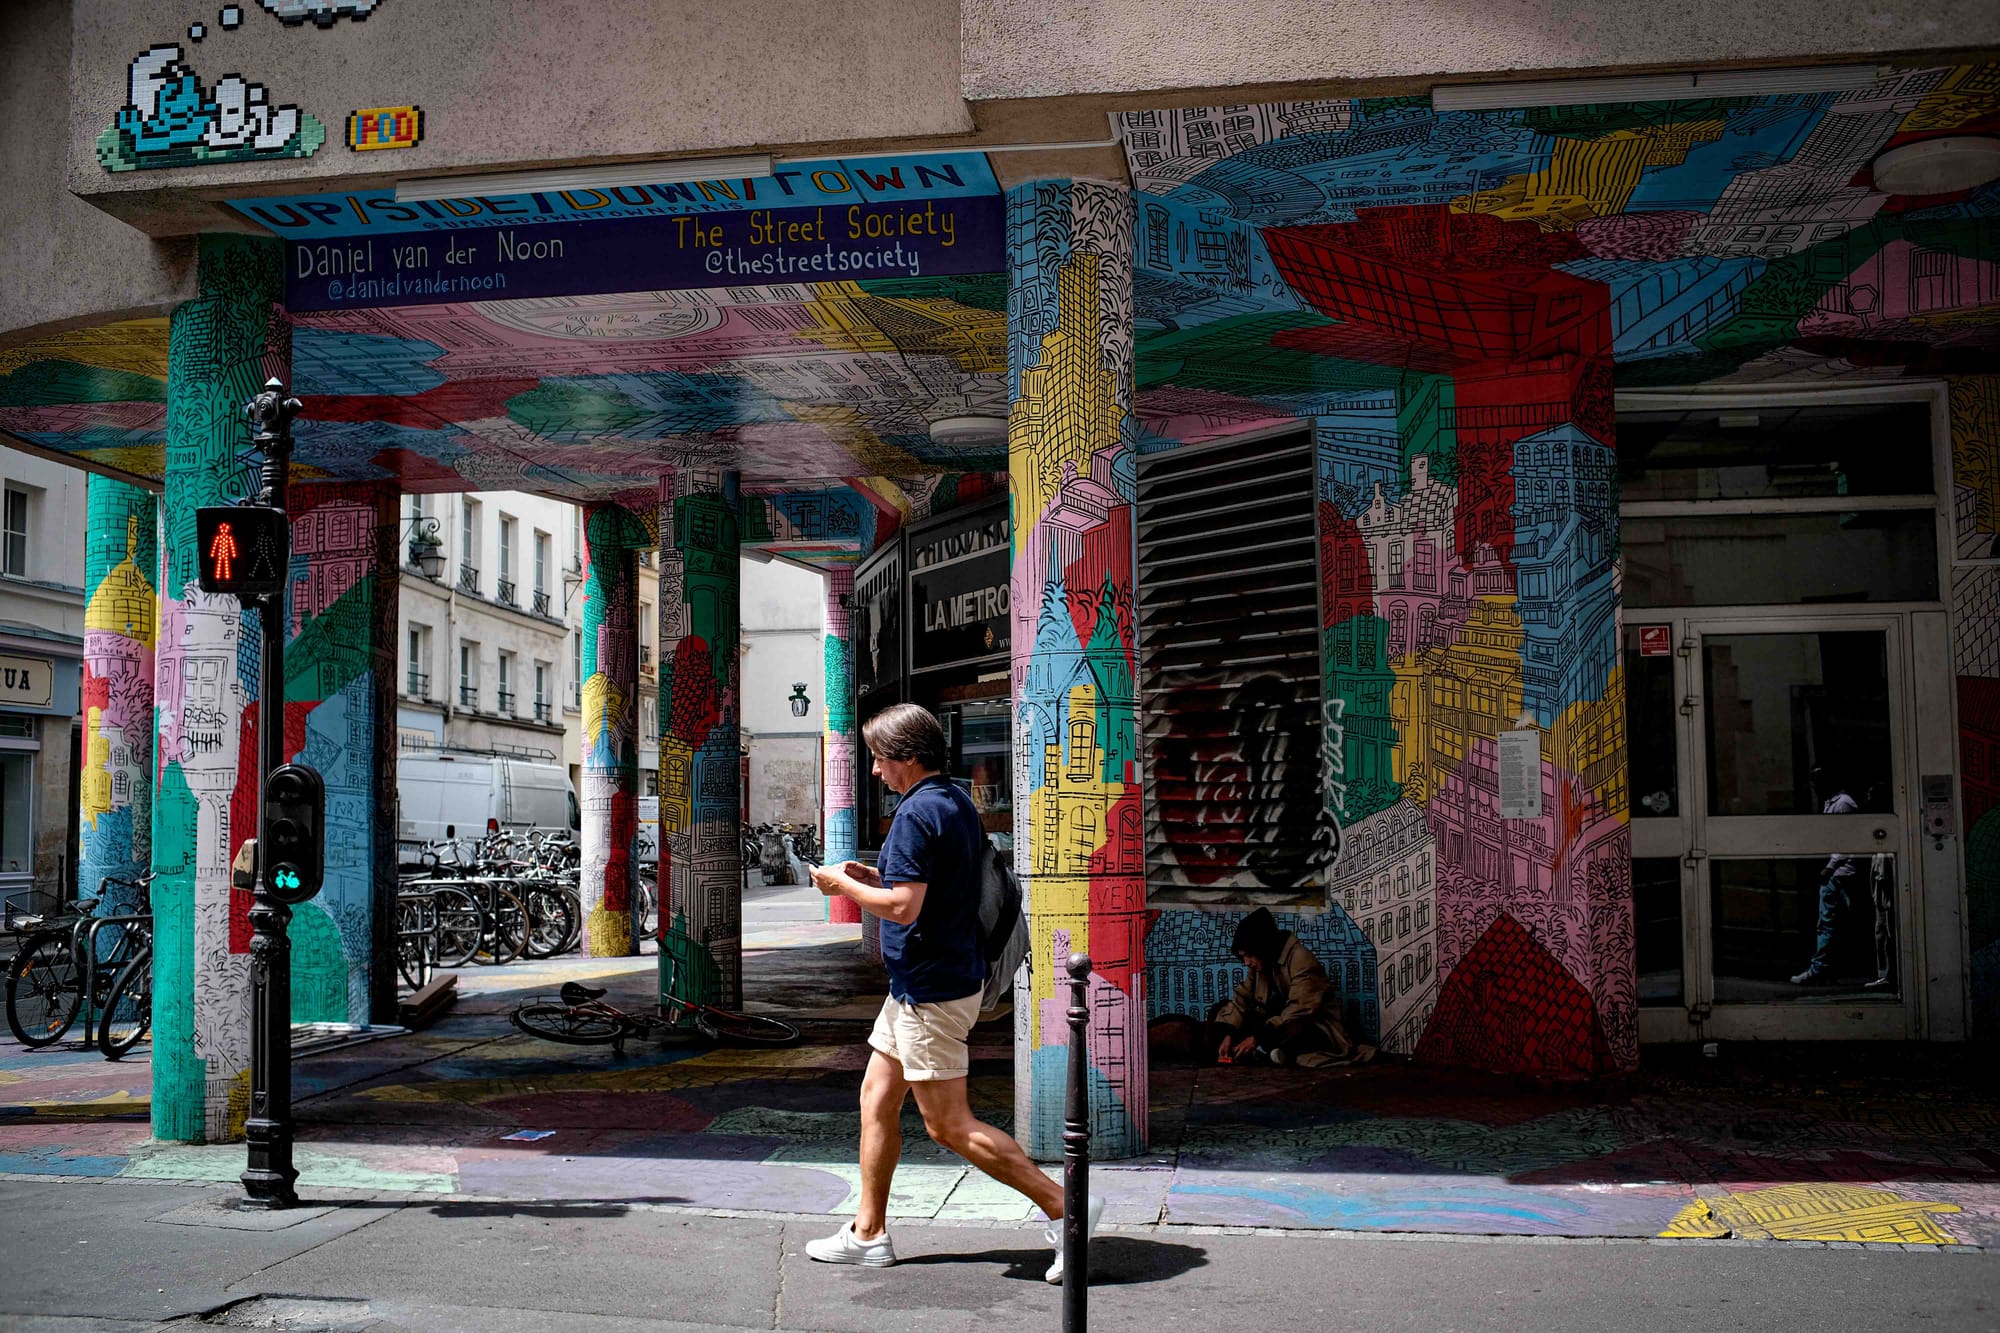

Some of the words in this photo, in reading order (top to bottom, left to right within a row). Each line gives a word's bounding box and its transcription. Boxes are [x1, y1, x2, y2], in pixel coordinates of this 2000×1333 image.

[671, 215, 724, 249] The
[749, 207, 825, 246] Street
[847, 200, 956, 247] Society
[297, 240, 373, 279] Daniel
[392, 245, 429, 270] van
[445, 235, 477, 265] der
[497, 230, 565, 263] Noon
[327, 270, 507, 300] @danielvandernoon
[924, 600, 947, 633] LA
[0, 667, 31, 690] UA
[1472, 818, 1500, 839] CENTRE
